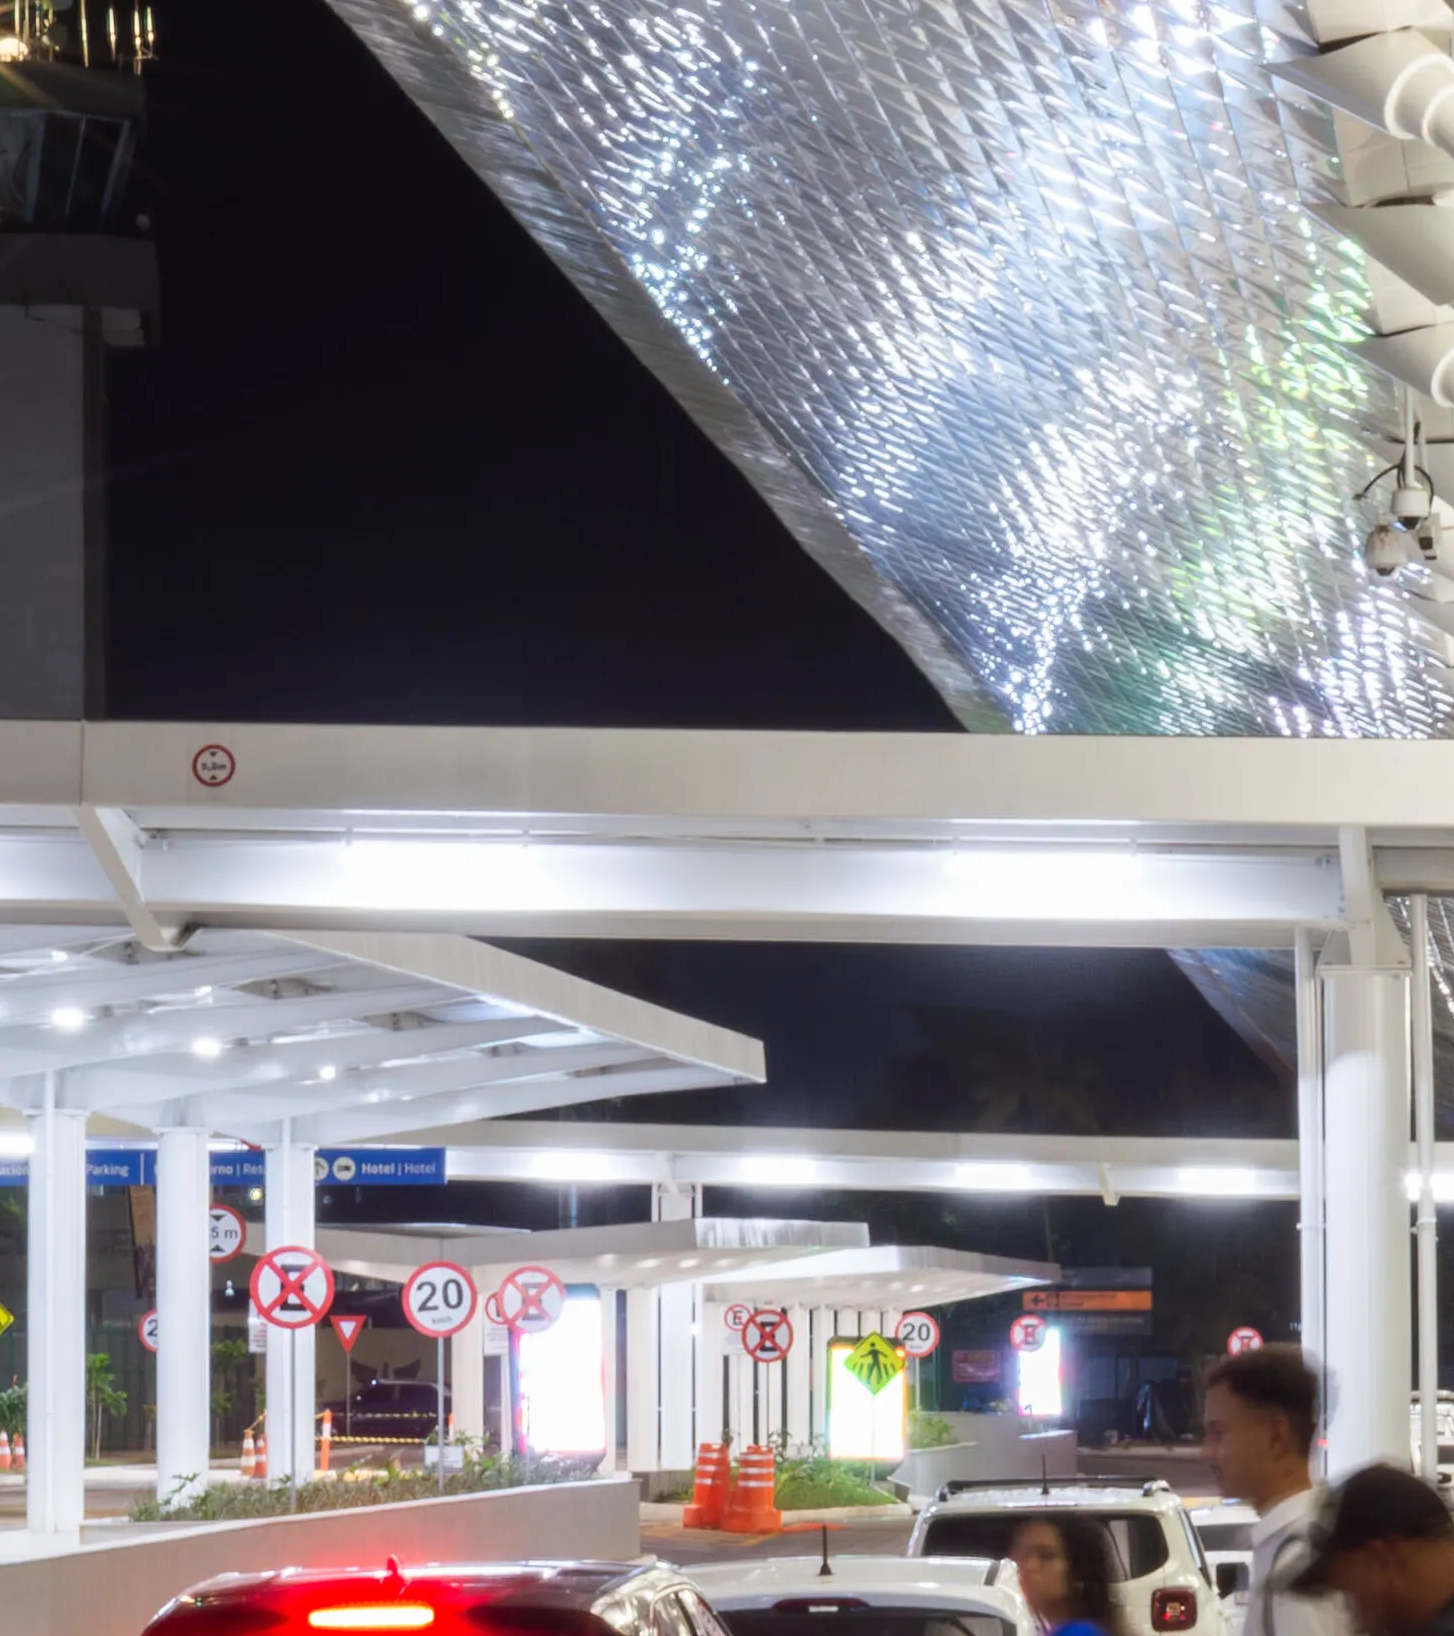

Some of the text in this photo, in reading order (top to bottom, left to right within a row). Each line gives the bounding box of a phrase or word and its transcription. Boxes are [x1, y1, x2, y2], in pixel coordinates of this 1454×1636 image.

[362, 1161, 436, 1174] Hotel Hotel
[416, 1278, 463, 1312] 20
[147, 1318, 158, 1337] 2
[903, 1322, 931, 1342] 20
